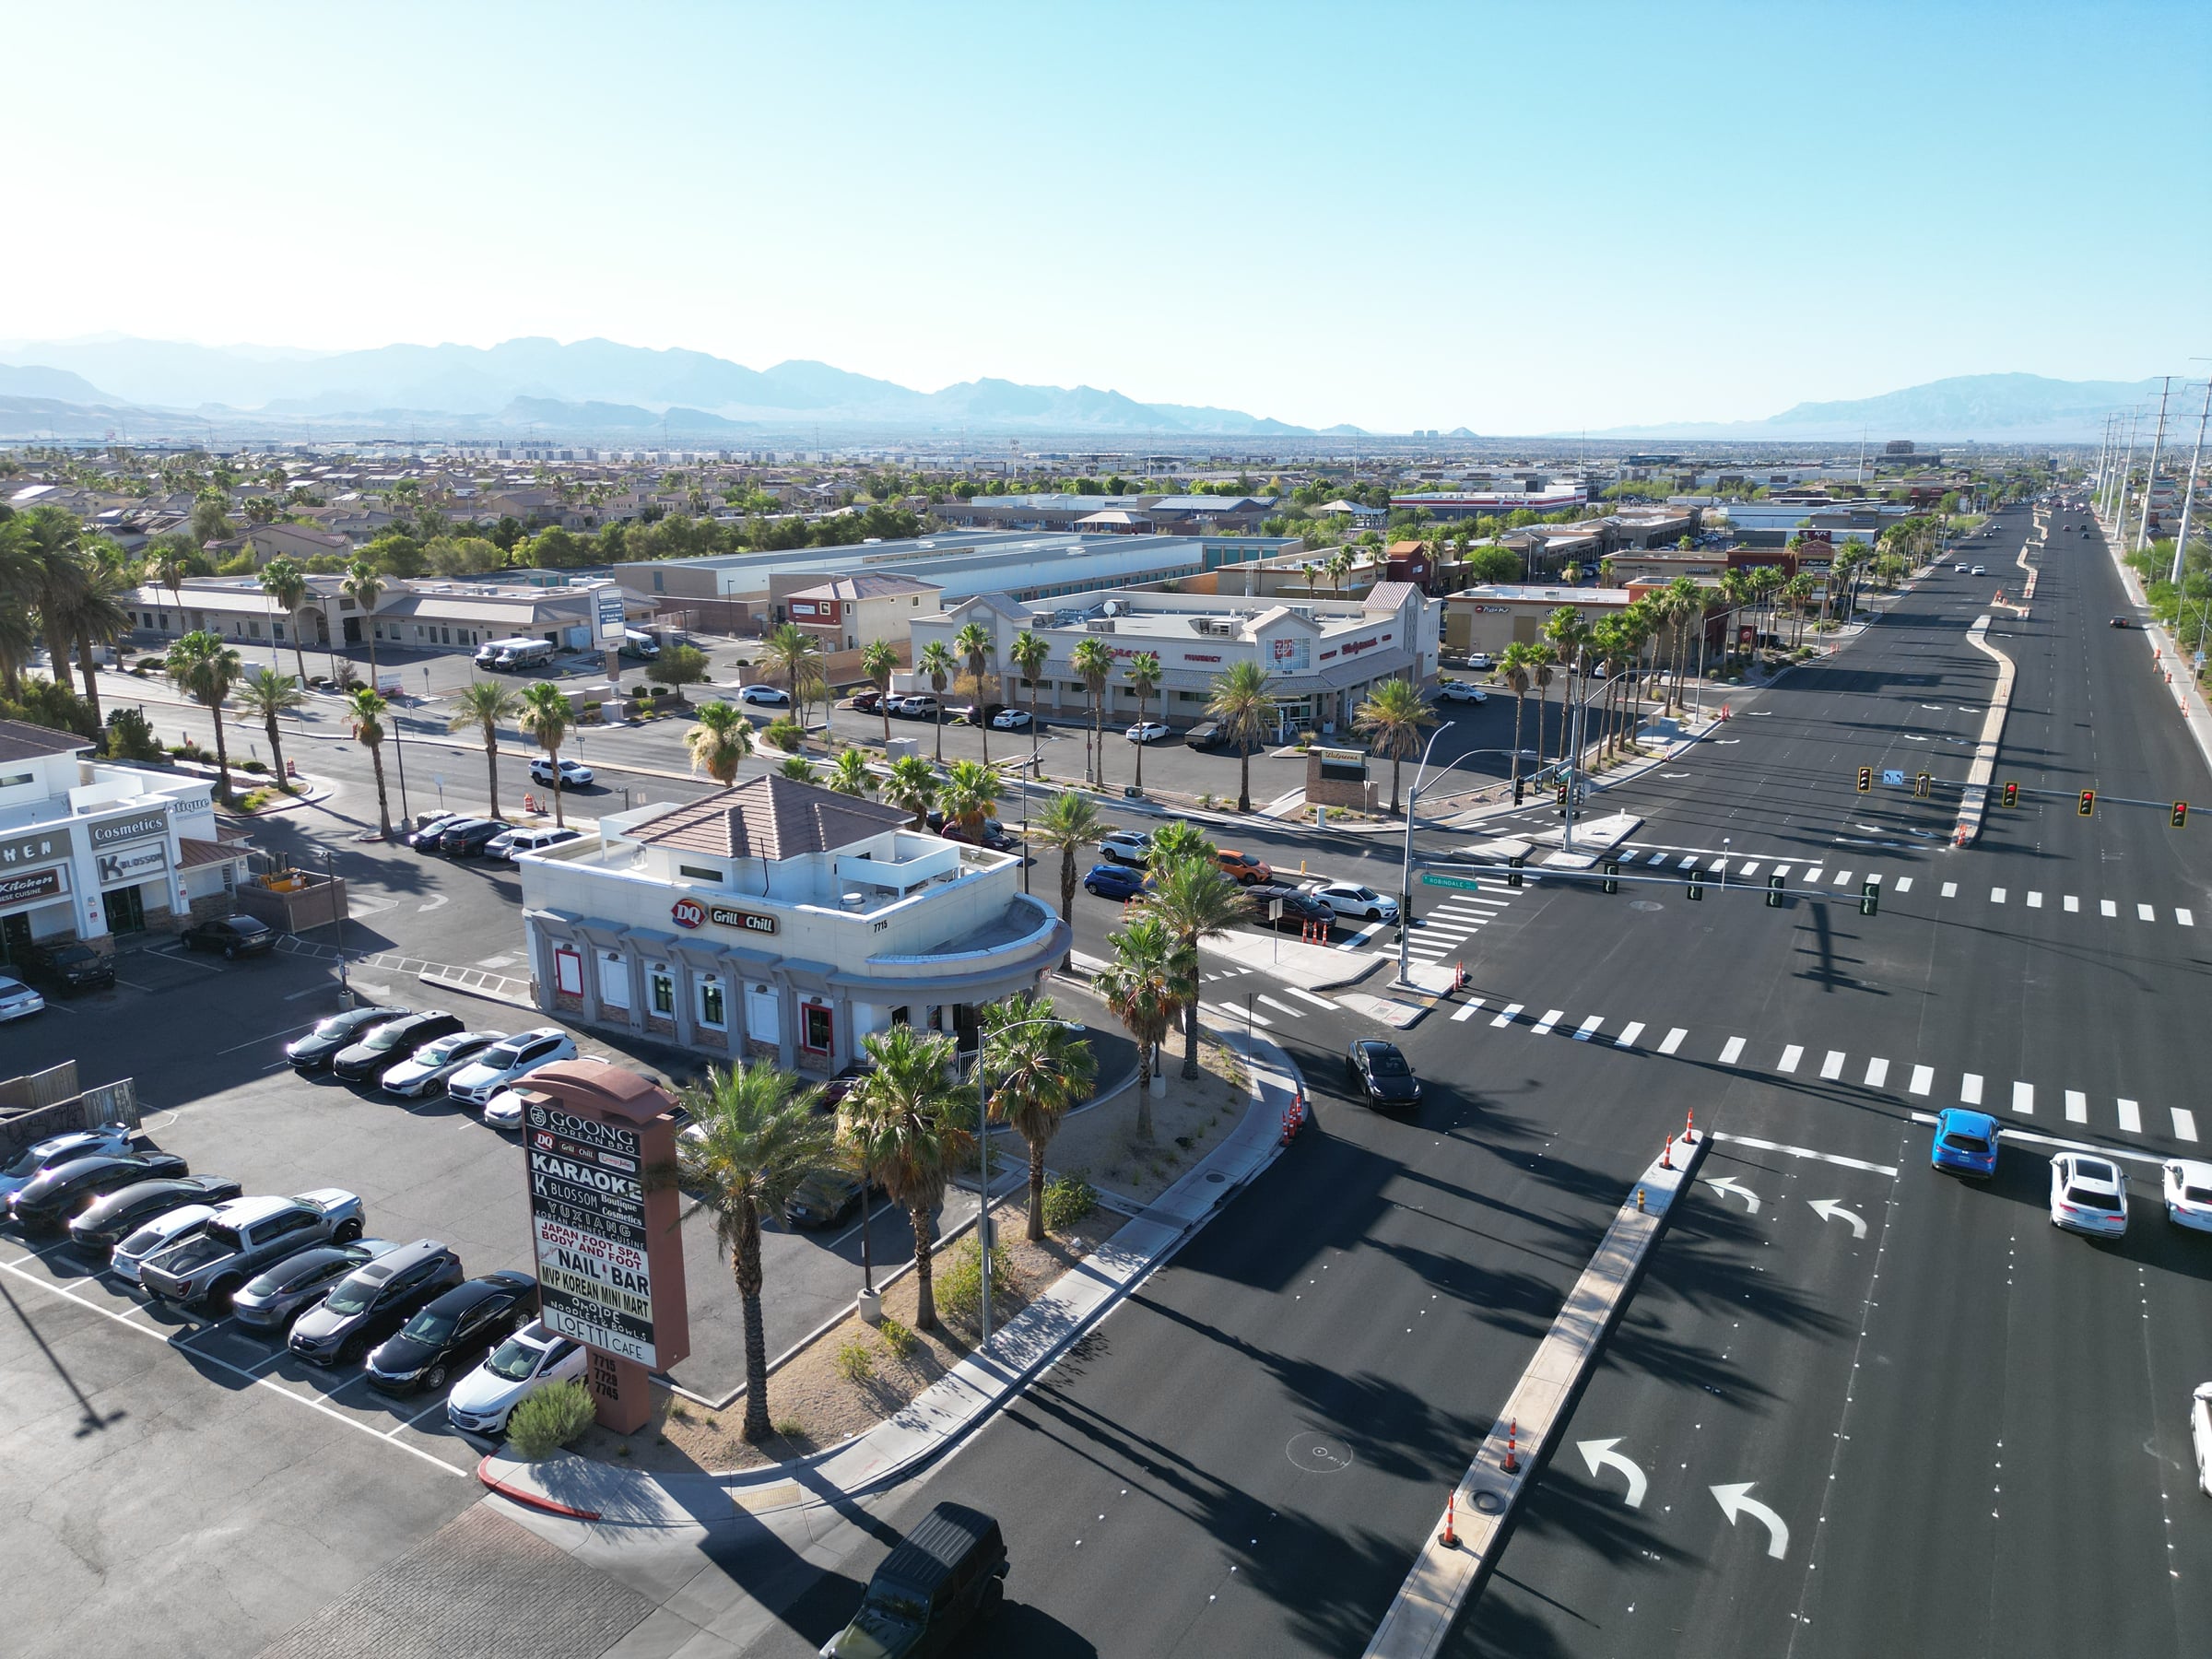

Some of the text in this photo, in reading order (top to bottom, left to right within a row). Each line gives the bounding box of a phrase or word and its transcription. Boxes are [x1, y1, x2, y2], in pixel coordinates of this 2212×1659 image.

[1325, 751, 1359, 760] Walgreens
[174, 798, 209, 813] tique
[94, 817, 163, 841] Cosmetics
[100, 852, 164, 881] K BLOSSOM
[0, 876, 53, 893] Kitchen
[15, 888, 41, 898] CUISINE
[1430, 877, 1465, 888] ROBINDALE
[677, 903, 772, 932] DQ Grill Chill
[874, 920, 888, 933] 7715
[549, 1112, 634, 1145] GOONG
[551, 1124, 635, 1154] KOREAN BBQ
[537, 1134, 594, 1158] DQ Grill Chill
[531, 1152, 643, 1202] KARAOKE
[535, 1174, 597, 1207] K BLOSSOM
[601, 1194, 638, 1212] Boutique
[602, 1206, 642, 1226] Cosmetics
[535, 1209, 645, 1250] KOREAN CHINESE CUISINE
[547, 1200, 631, 1237] YUXIANG
[542, 1222, 641, 1262] JAPAN FOOT SPA
[542, 1230, 574, 1248] BODY
[579, 1243, 605, 1258] AND
[608, 1253, 641, 1270] FOOT
[559, 1248, 601, 1279] NAIL
[611, 1266, 649, 1296] BAR
[542, 1265, 649, 1318] MVP KOREAN MINI MART
[550, 1300, 647, 1341] NOODLES & BOWLS
[571, 1297, 620, 1324] OMOIDE
[557, 1312, 642, 1360] LOFTTI CAFE
[594, 1353, 616, 1372] 7715
[595, 1382, 618, 1401] 7745
